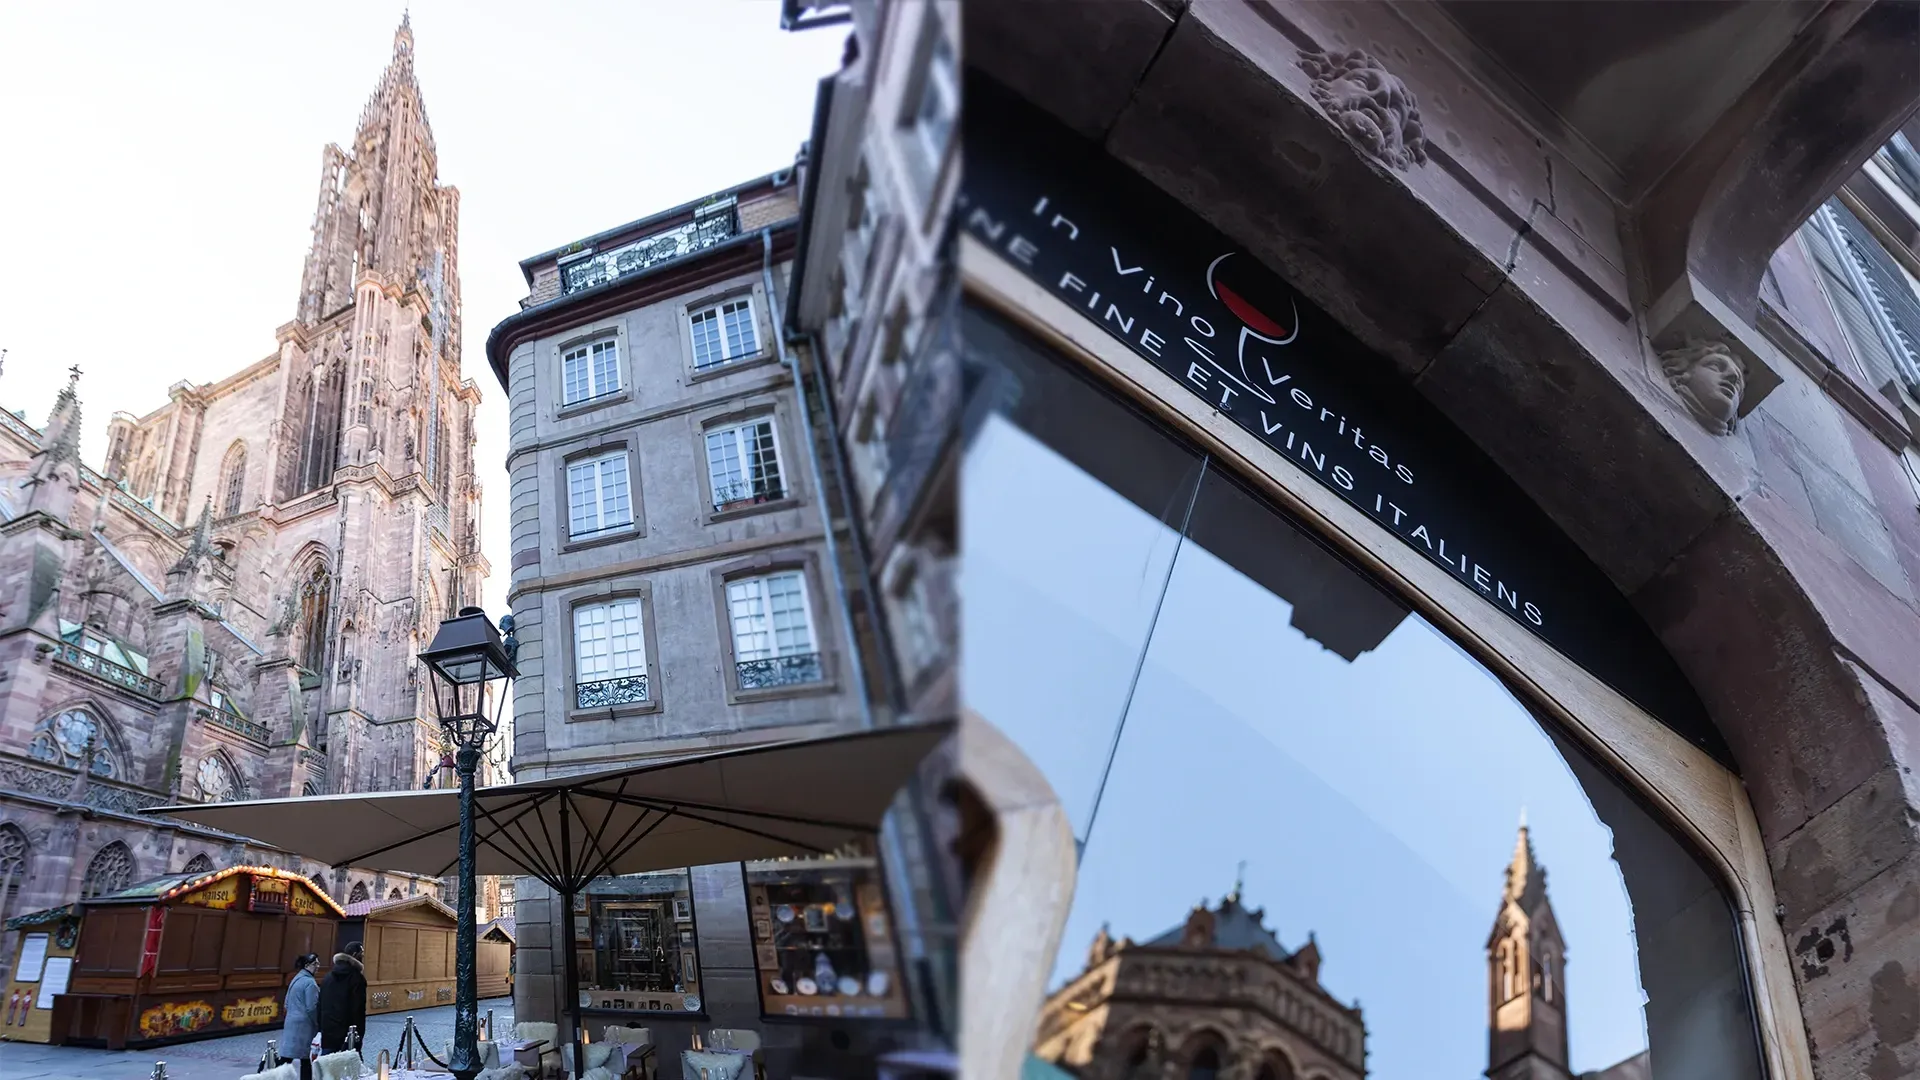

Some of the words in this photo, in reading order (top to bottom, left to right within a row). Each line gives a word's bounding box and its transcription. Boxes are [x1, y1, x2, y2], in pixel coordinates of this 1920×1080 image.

[1032, 196, 1080, 241] In
[1111, 246, 1216, 338] Vino
[1261, 356, 1414, 485] Veritas
[1058, 271, 1167, 358] FINE
[1186, 361, 1239, 404] ET
[1260, 410, 1355, 491] VINS
[1374, 494, 1543, 626] ITALIENS
